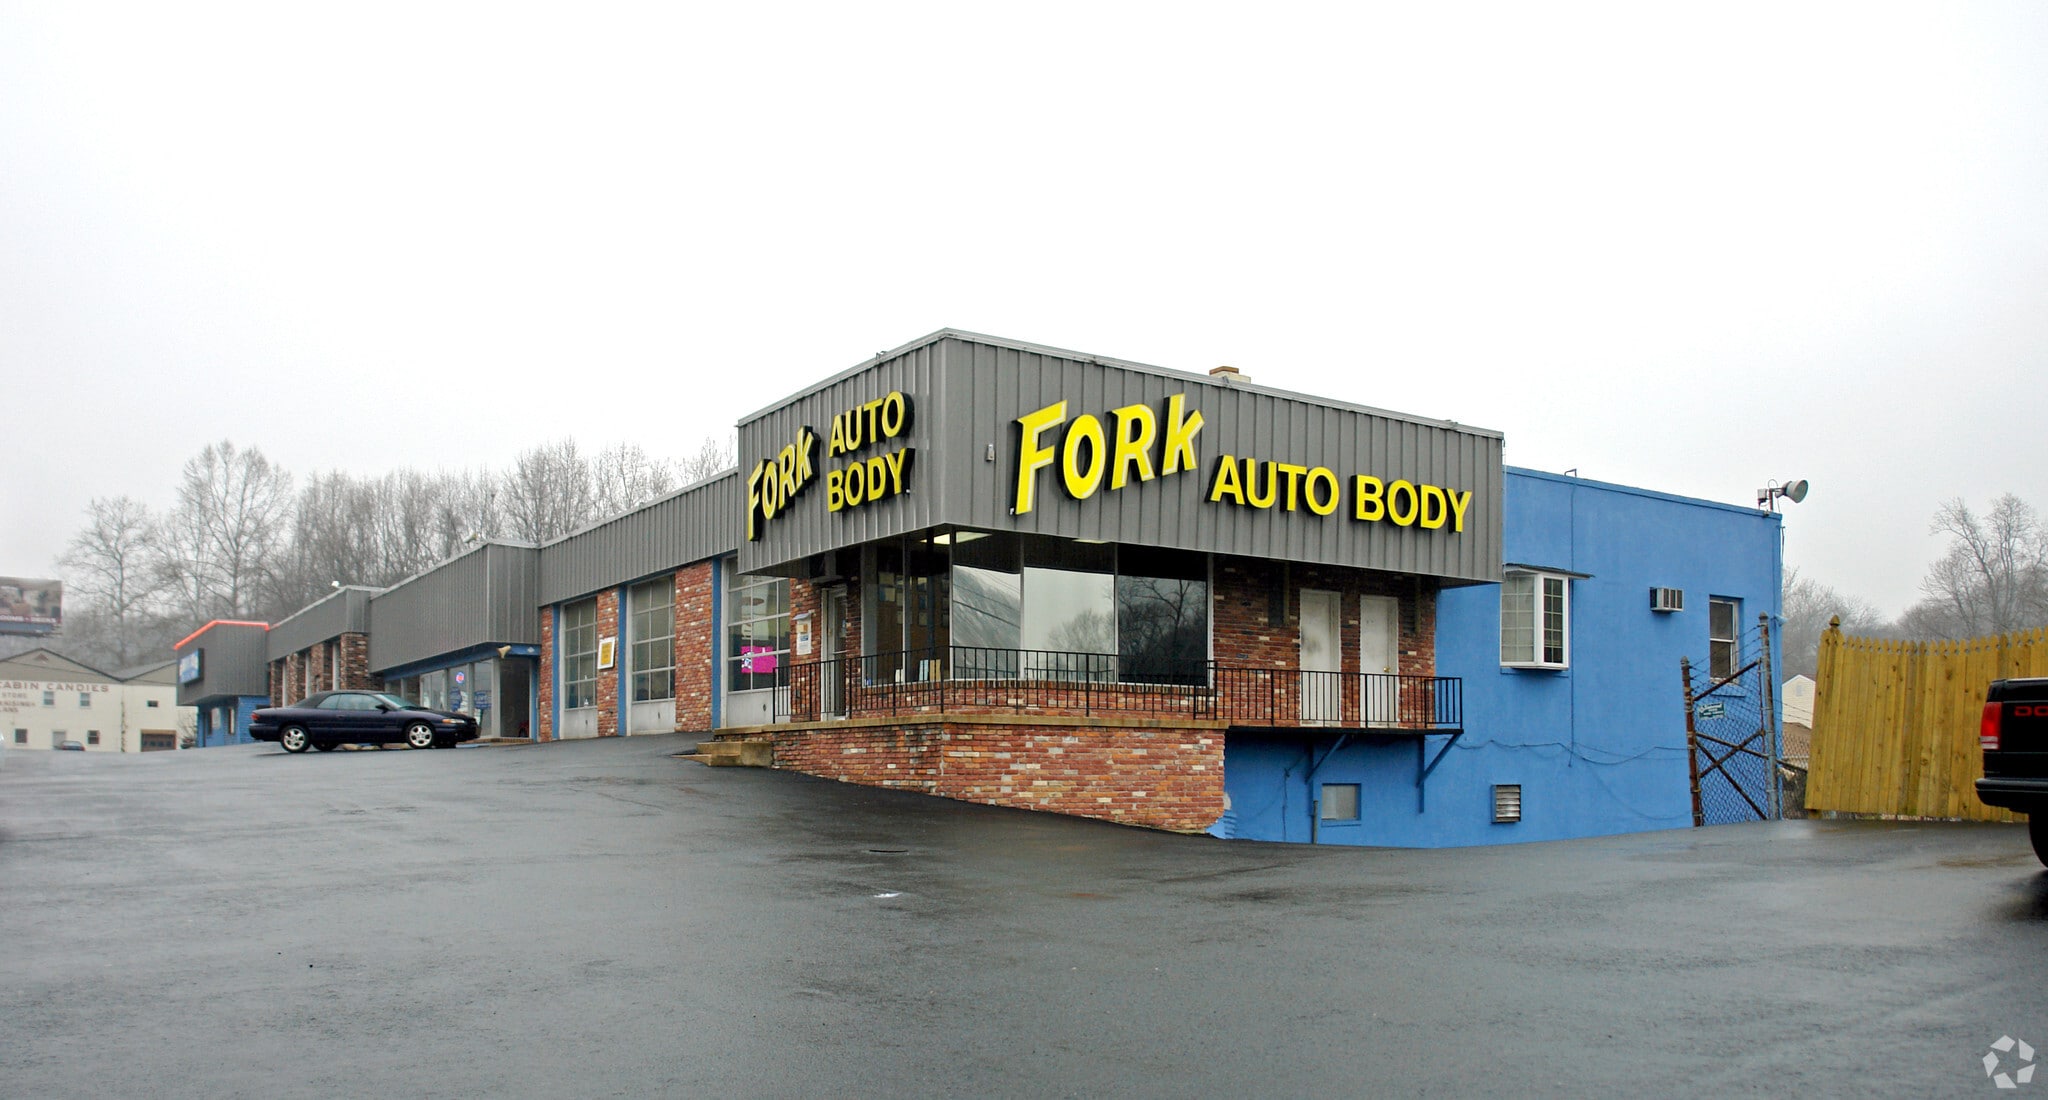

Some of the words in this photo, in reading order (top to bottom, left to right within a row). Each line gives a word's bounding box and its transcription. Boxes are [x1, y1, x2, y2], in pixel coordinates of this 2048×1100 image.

[829, 390, 912, 458] AUTO
[827, 447, 912, 513] BODY
[1209, 454, 1340, 517] AUTO
[1351, 474, 1473, 533] BODY
[46, 682, 110, 692] CANDIES
